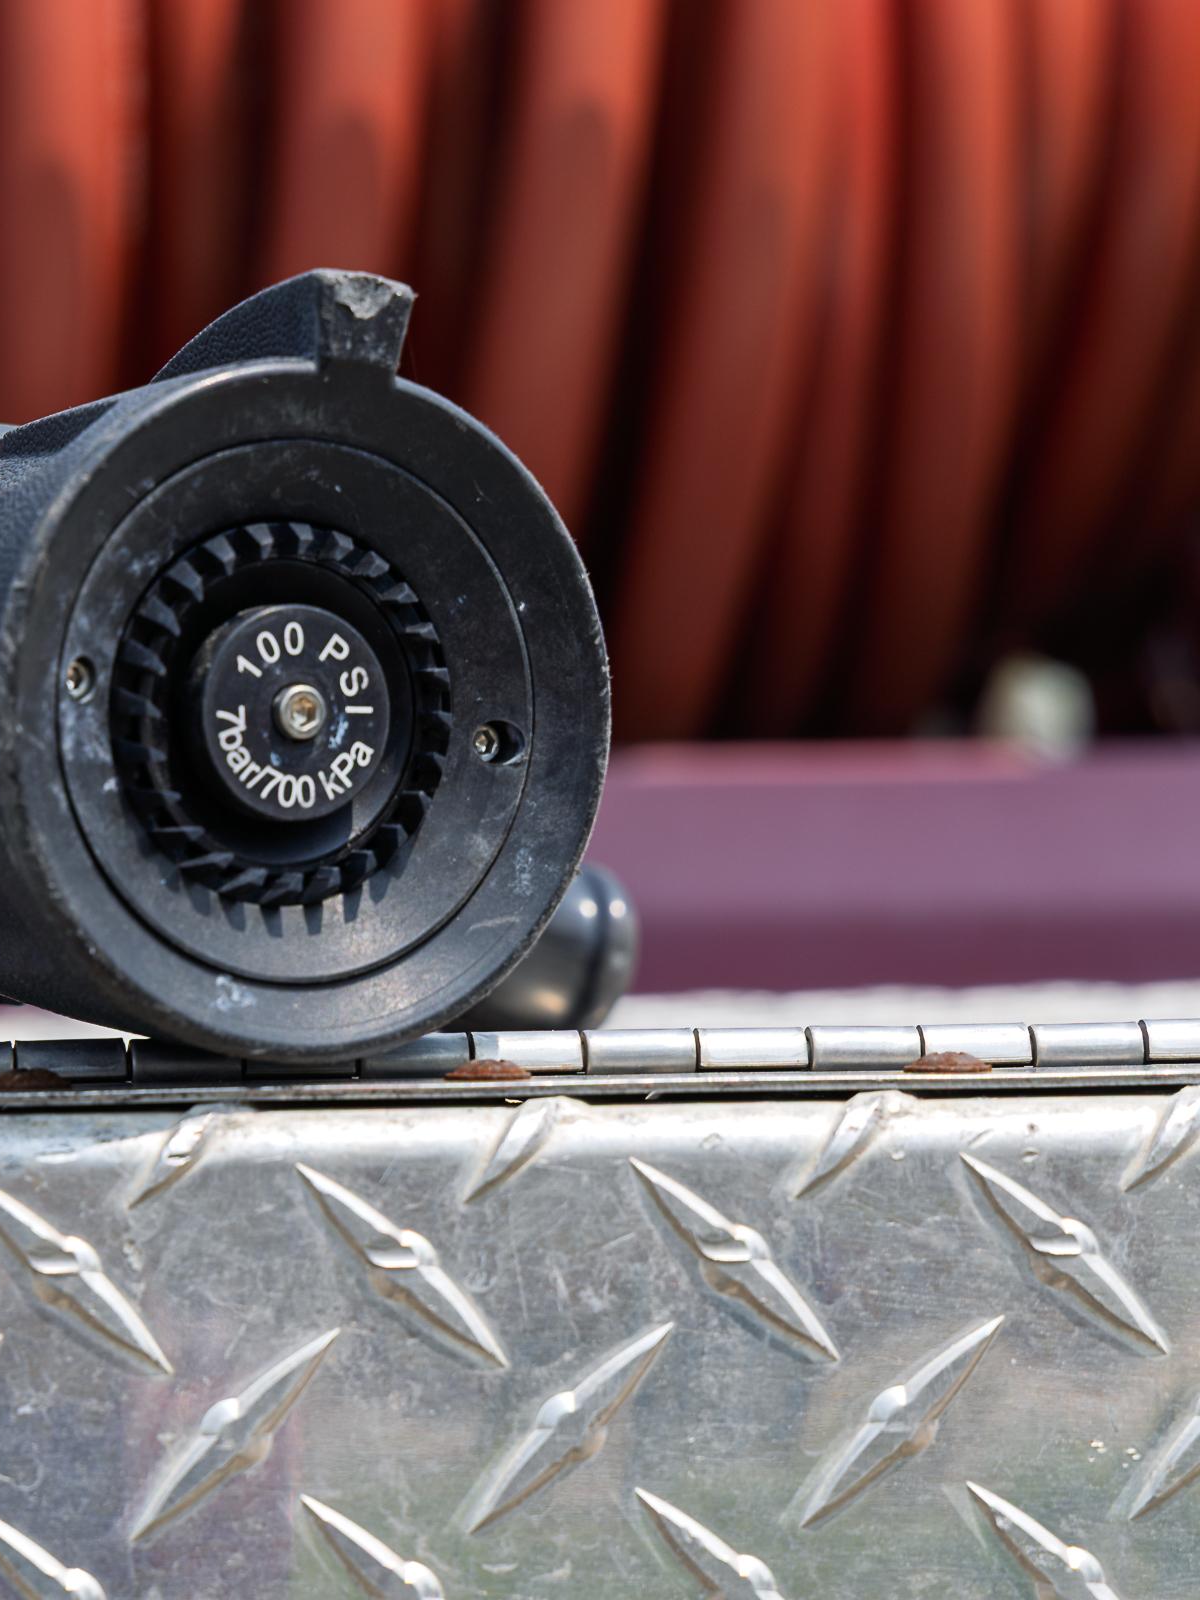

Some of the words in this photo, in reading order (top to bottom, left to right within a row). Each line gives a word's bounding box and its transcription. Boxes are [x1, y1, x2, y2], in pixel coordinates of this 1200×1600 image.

[236, 621, 305, 678] 100
[318, 633, 374, 714] PSI
[317, 741, 375, 800] kPa
